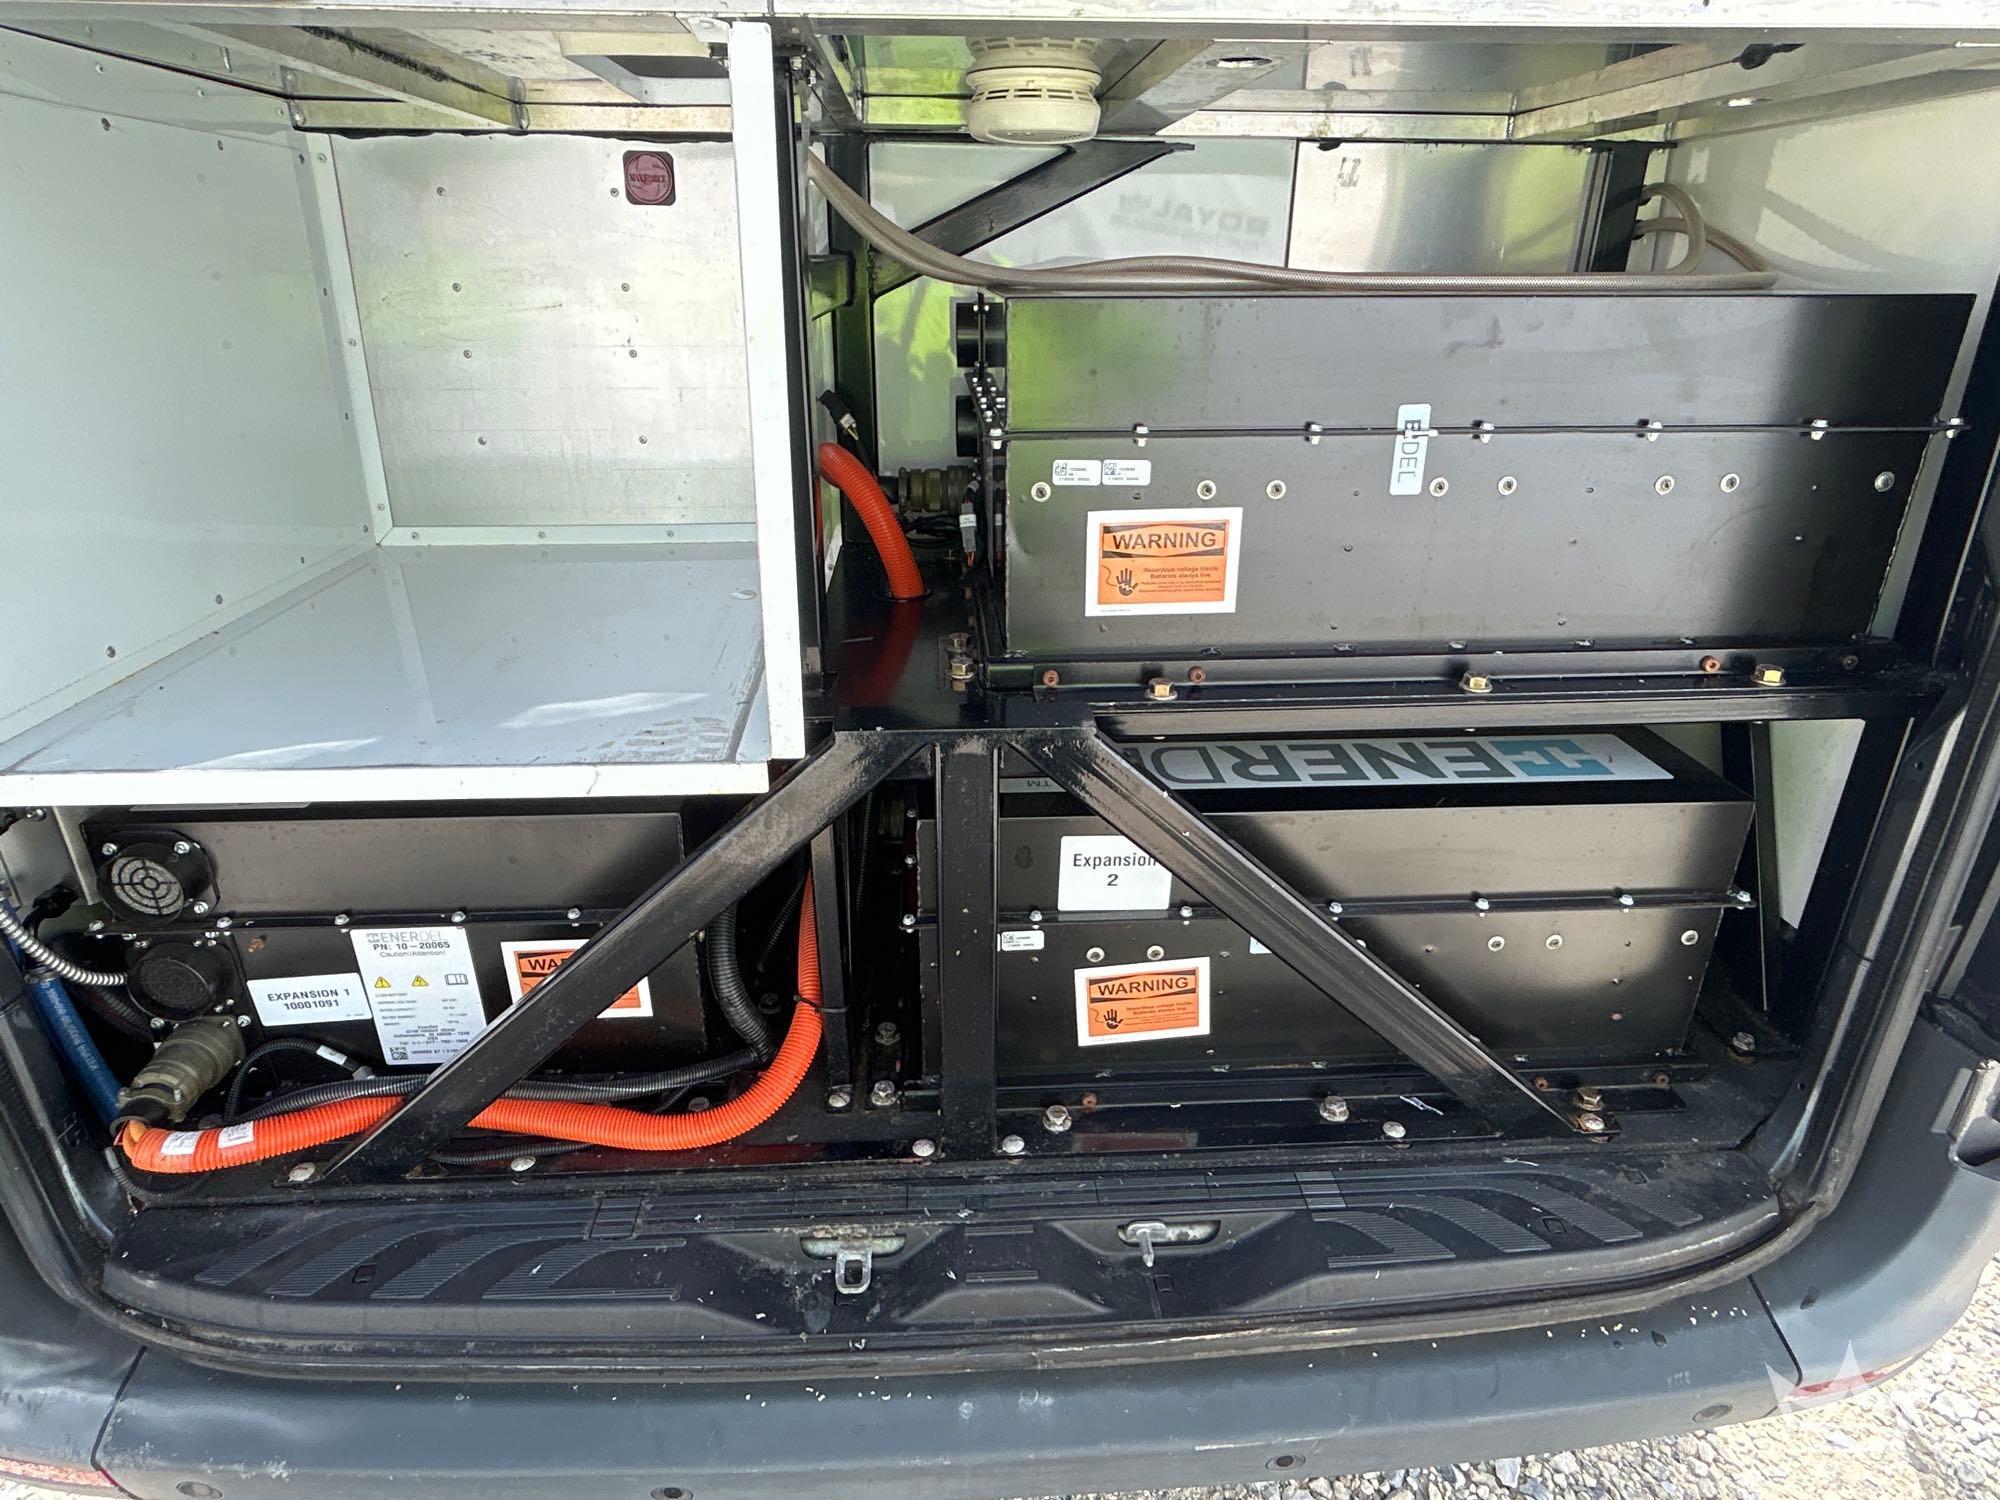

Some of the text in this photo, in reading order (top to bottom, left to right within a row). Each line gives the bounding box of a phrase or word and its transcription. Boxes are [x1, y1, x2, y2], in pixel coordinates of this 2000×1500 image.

[1113, 531, 1216, 549] WARNING
[1073, 853, 1156, 870] Expansion
[1107, 873, 1118, 886] 2
[380, 930, 446, 943] ENERDEL
[373, 943, 392, 951] PN:
[1098, 977, 1188, 996] WARNING
[267, 988, 350, 1002] EXPANSION 1
[283, 1000, 340, 1010] 10001091
